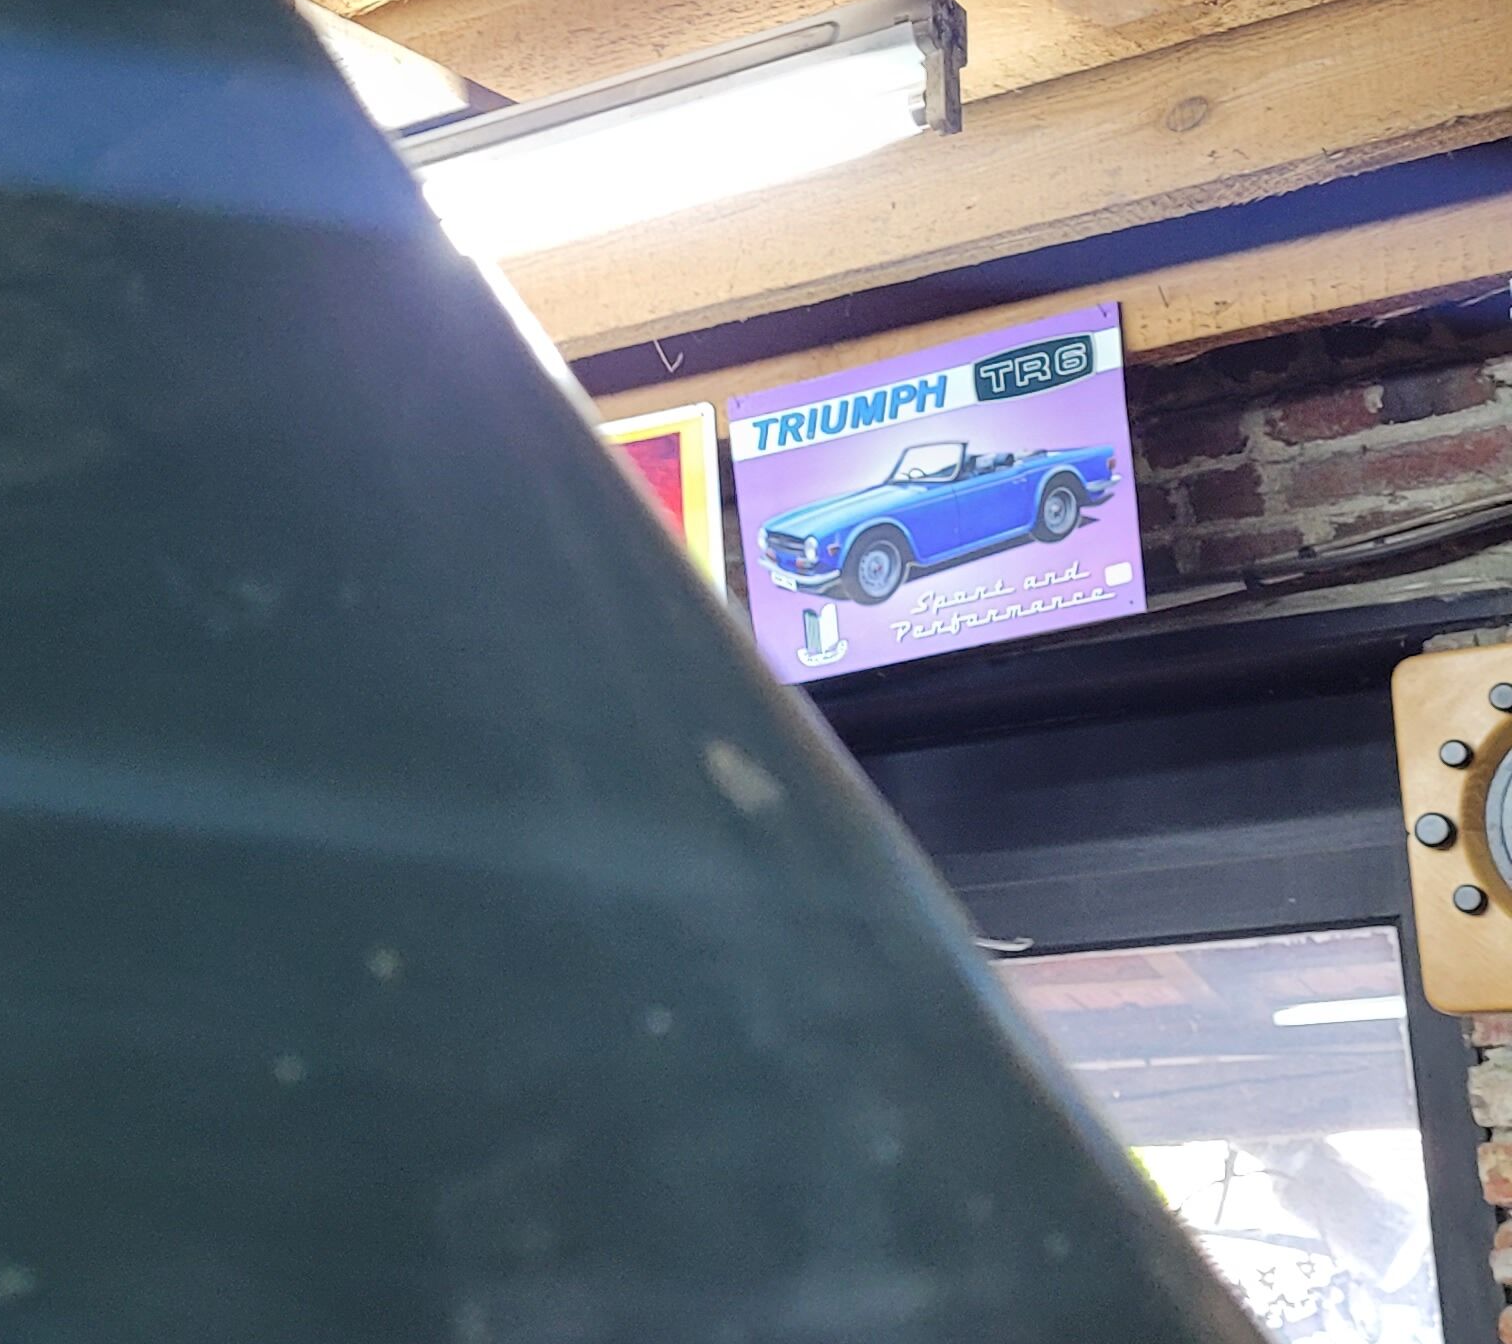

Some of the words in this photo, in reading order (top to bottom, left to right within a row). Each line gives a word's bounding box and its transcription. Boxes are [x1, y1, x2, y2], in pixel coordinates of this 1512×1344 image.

[752, 375, 947, 451] TRIUMPH
[979, 342, 1087, 394] TR6
[889, 586, 1117, 644] Performance
[910, 578, 1016, 617] Sport
[1023, 560, 1092, 590] and
